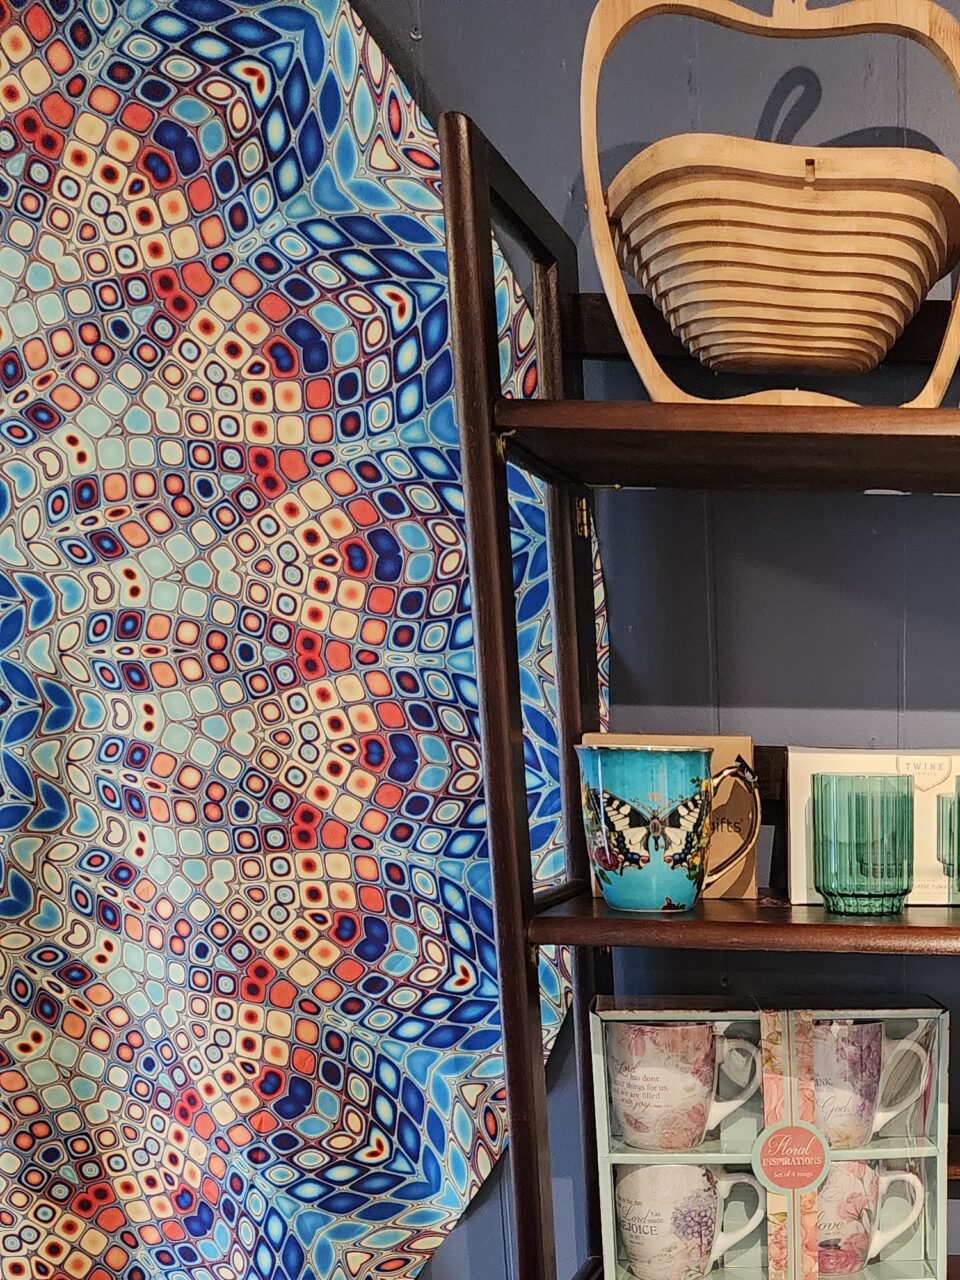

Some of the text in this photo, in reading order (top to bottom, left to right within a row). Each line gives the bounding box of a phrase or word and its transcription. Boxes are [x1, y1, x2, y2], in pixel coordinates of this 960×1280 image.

[905, 763, 945, 771] TWINE
[642, 1074, 660, 1082] done
[768, 1134, 816, 1156] Floral
[762, 1156, 822, 1167] INSPIRATIONS
